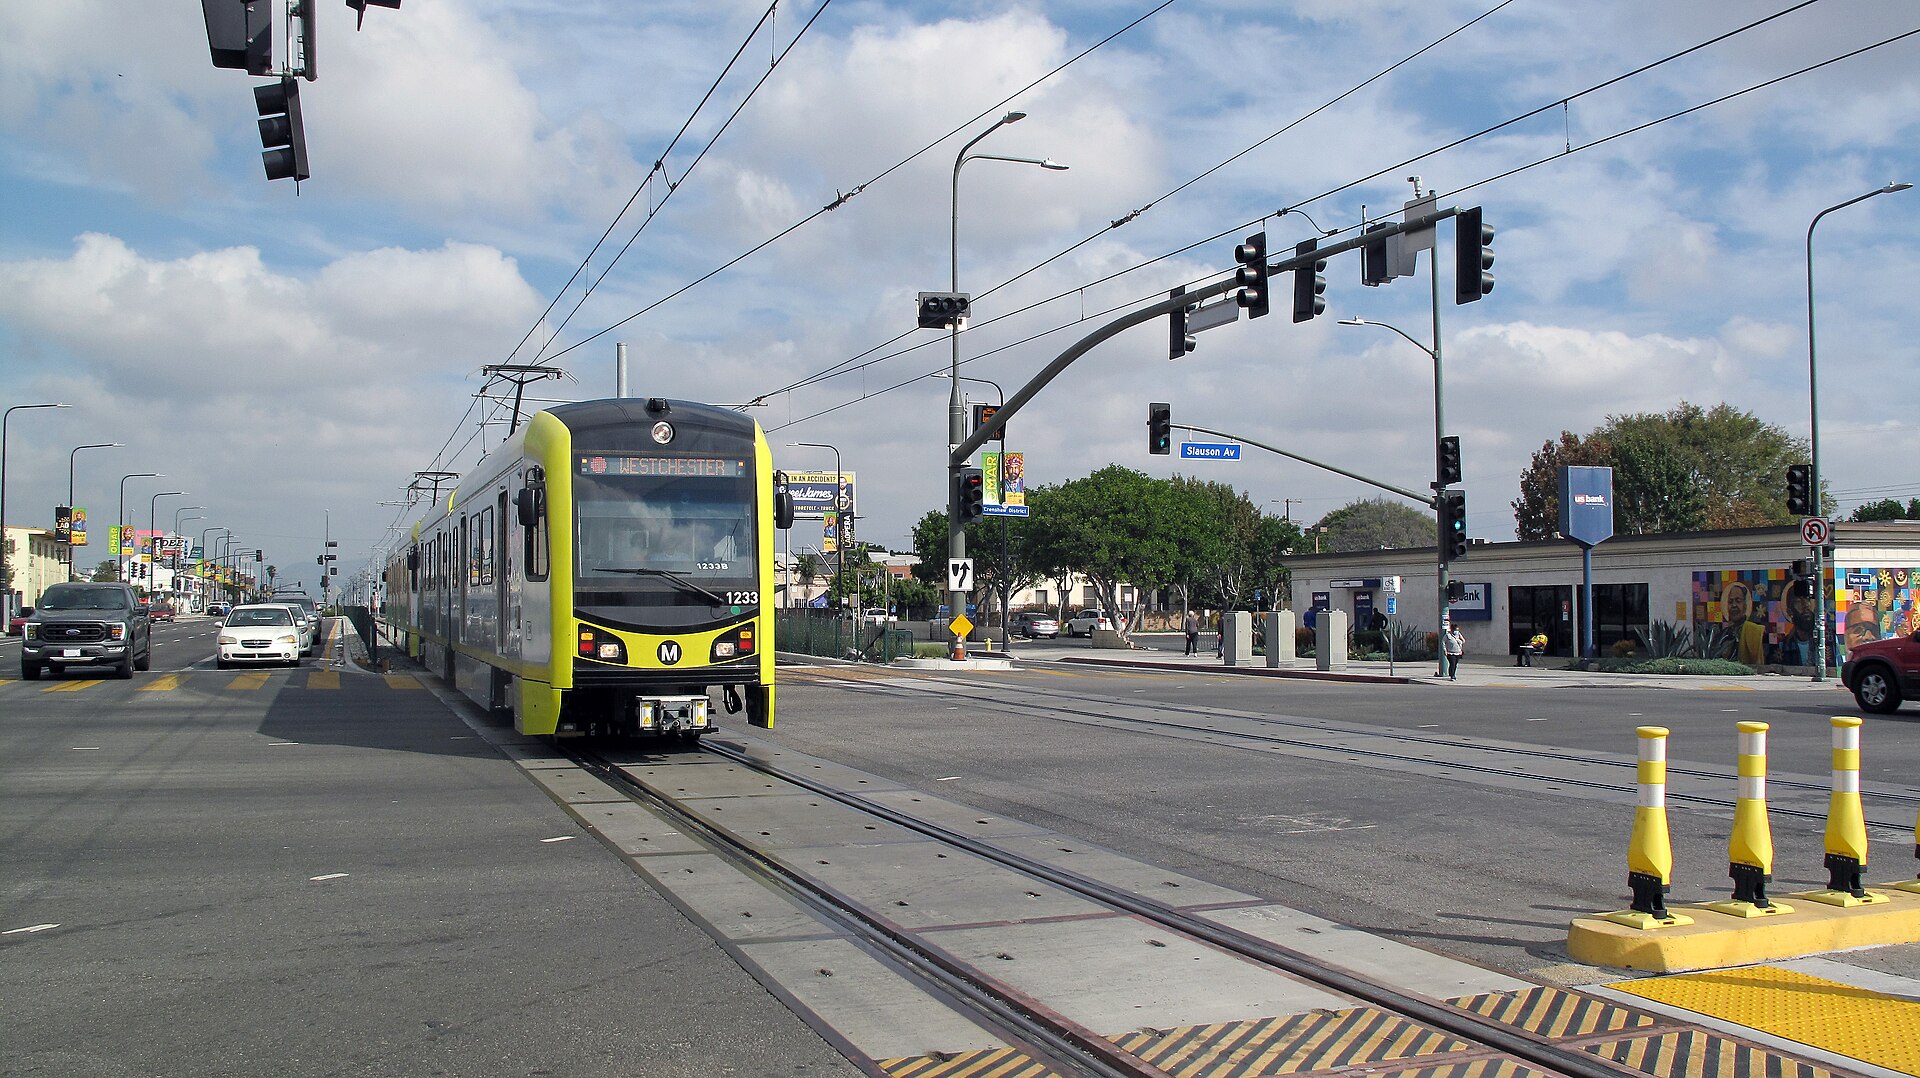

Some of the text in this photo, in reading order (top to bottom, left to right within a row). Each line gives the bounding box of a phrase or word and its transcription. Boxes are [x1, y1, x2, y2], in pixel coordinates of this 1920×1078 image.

[1186, 446, 1235, 457] Slauson Av
[619, 457, 725, 476] WESTCHESTER
[806, 475, 836, 483] ACCIDENT?
[985, 456, 998, 502] OMAR
[1585, 494, 1605, 503] bank
[111, 527, 119, 554] OMAR
[696, 562, 729, 570] 1233B
[725, 591, 759, 605] 1233
[661, 644, 678, 662] M
